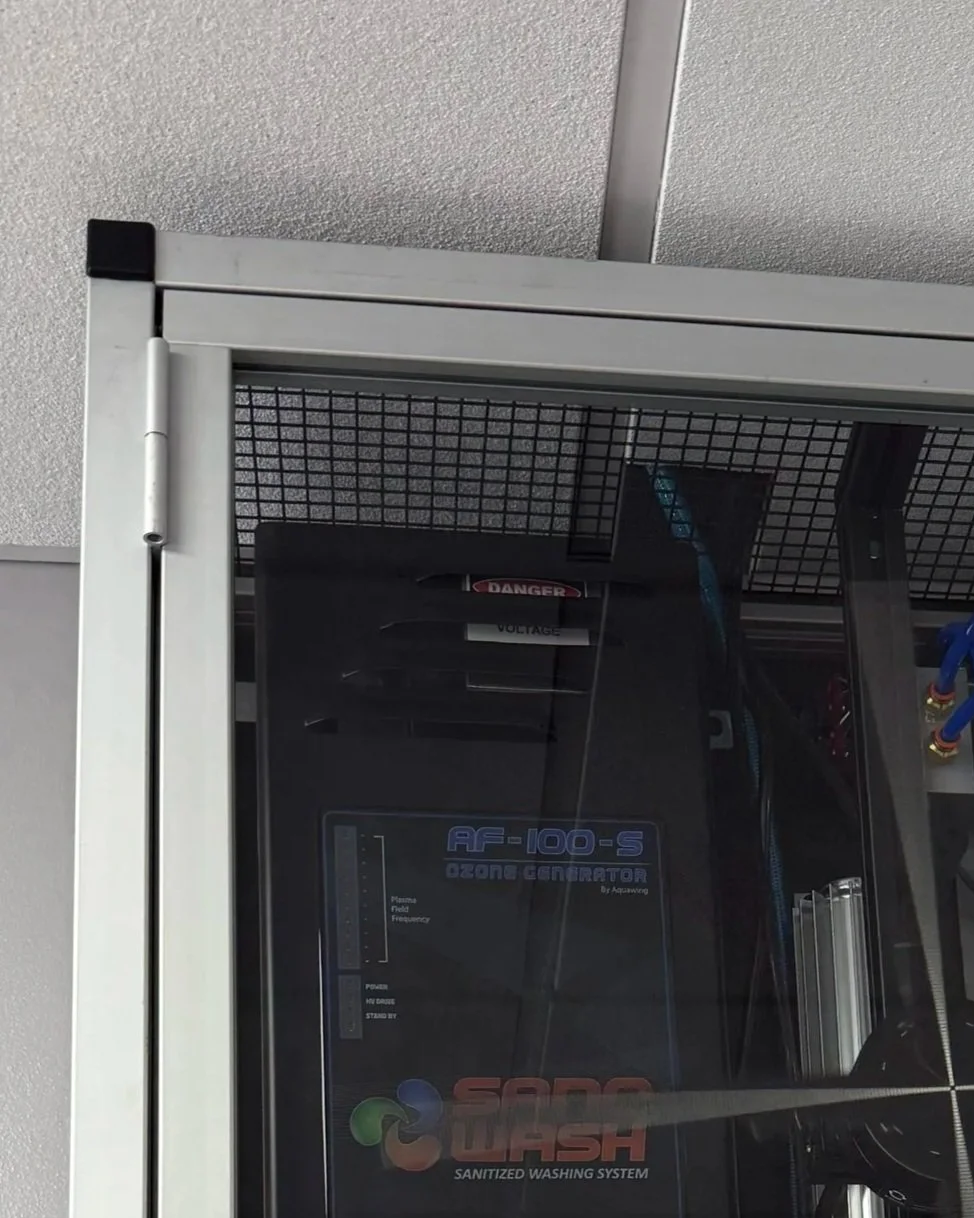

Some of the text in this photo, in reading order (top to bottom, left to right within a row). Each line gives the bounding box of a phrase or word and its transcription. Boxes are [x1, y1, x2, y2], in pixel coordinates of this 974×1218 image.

[487, 581, 566, 598] DANGER
[497, 623, 561, 637] VOLTAGE
[447, 825, 644, 857] AF-100-S
[445, 863, 648, 884] OZONE GENERATOR
[391, 915, 431, 924] Frequency
[450, 1120, 647, 1163] WASH
[454, 1167, 649, 1181] SANITIZED WASHING SYSTEM
